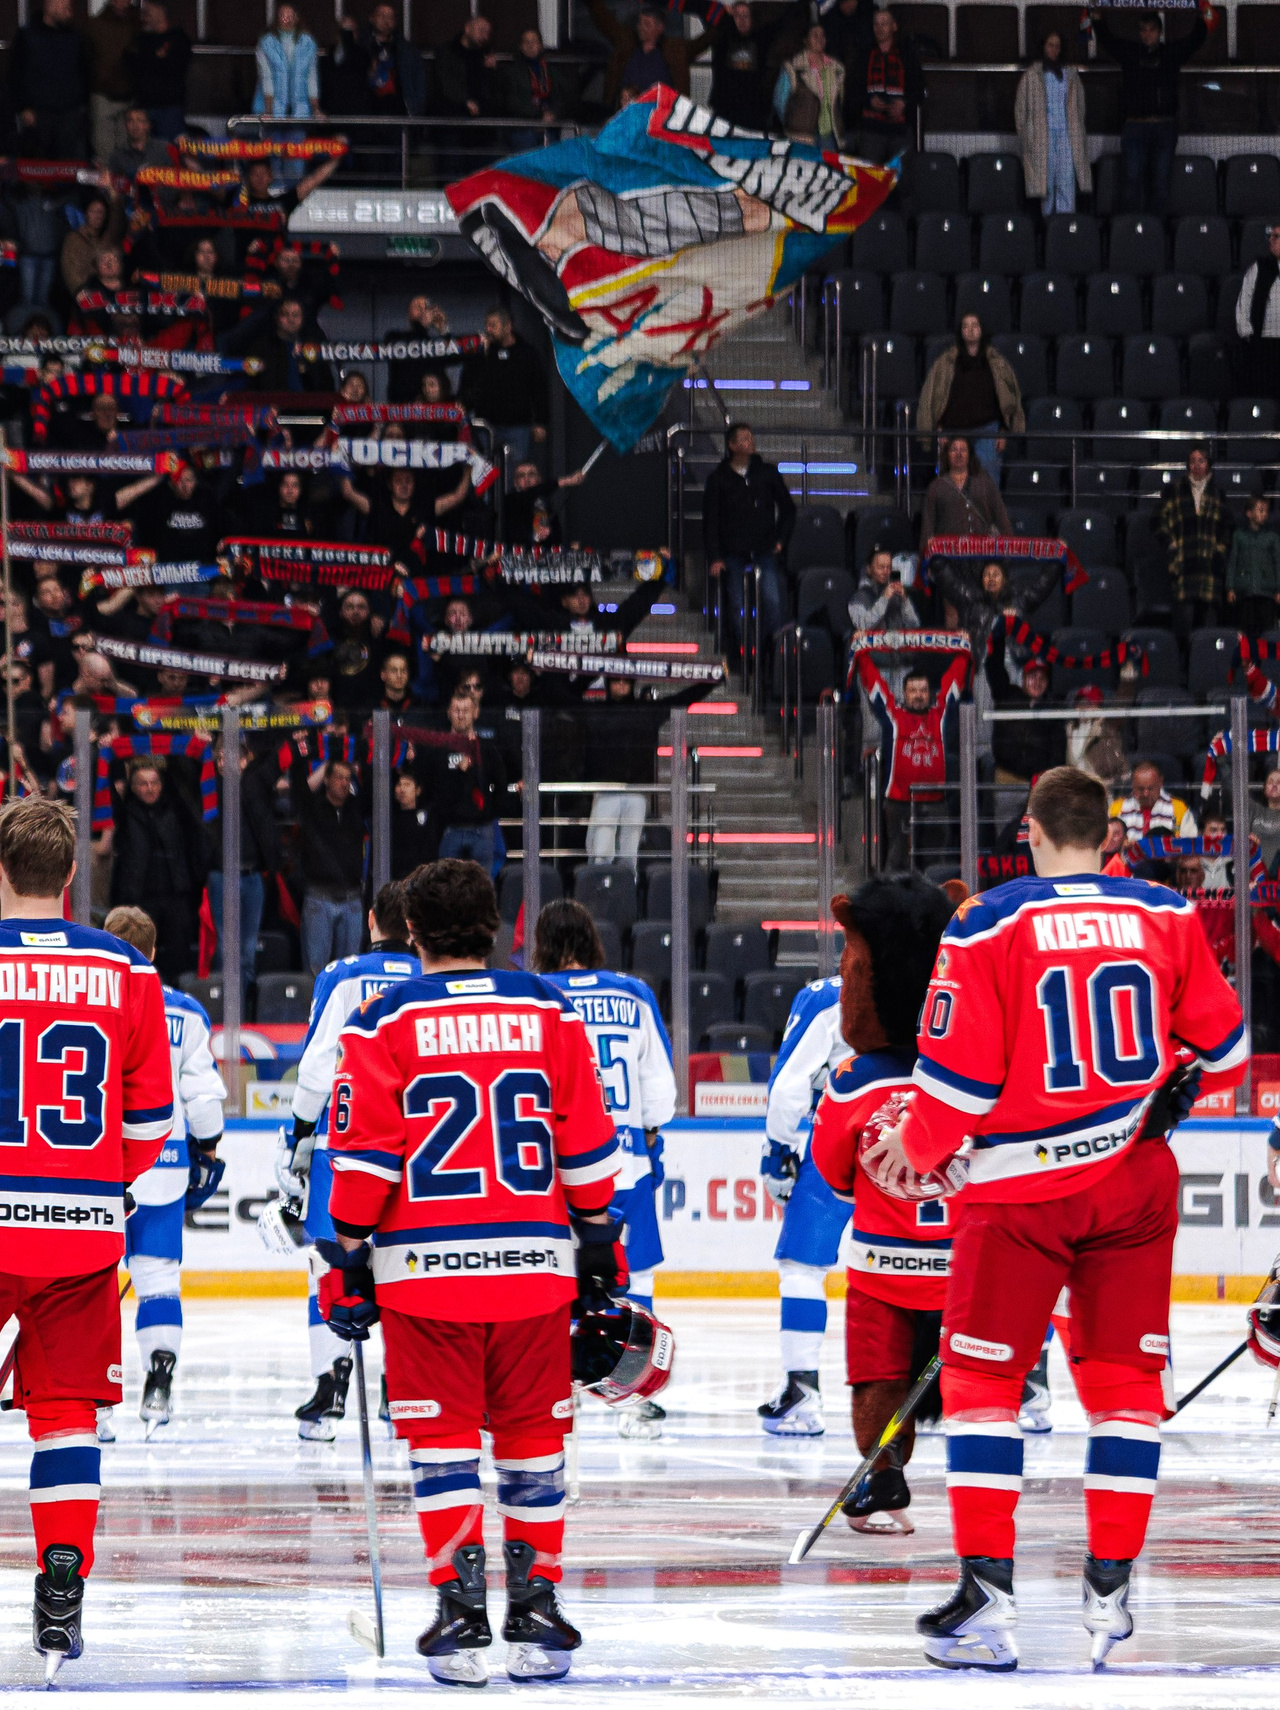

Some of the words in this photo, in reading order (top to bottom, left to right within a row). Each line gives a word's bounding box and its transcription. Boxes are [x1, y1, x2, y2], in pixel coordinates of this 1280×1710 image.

[354, 200, 402, 223] 213
[321, 343, 374, 362] ЦСКА
[378, 340, 459, 361] МОСКВА
[532, 651, 578, 670] ЦСКА
[581, 655, 669, 677] ПРЕВЫШЕ
[670, 662, 724, 680] ВСЕГО
[1032, 912, 1143, 952] KOSTIN
[573, 998, 635, 1027] STELYOV
[1036, 959, 1161, 1094] 10
[414, 1013, 543, 1058] BARACH
[334, 1083, 351, 1134] 6
[403, 1067, 556, 1203] 26
[879, 1256, 949, 1272] РОСНЕ
[953, 1339, 1005, 1356] OLIMPBET
[52, 1553, 74, 1561] CCM
